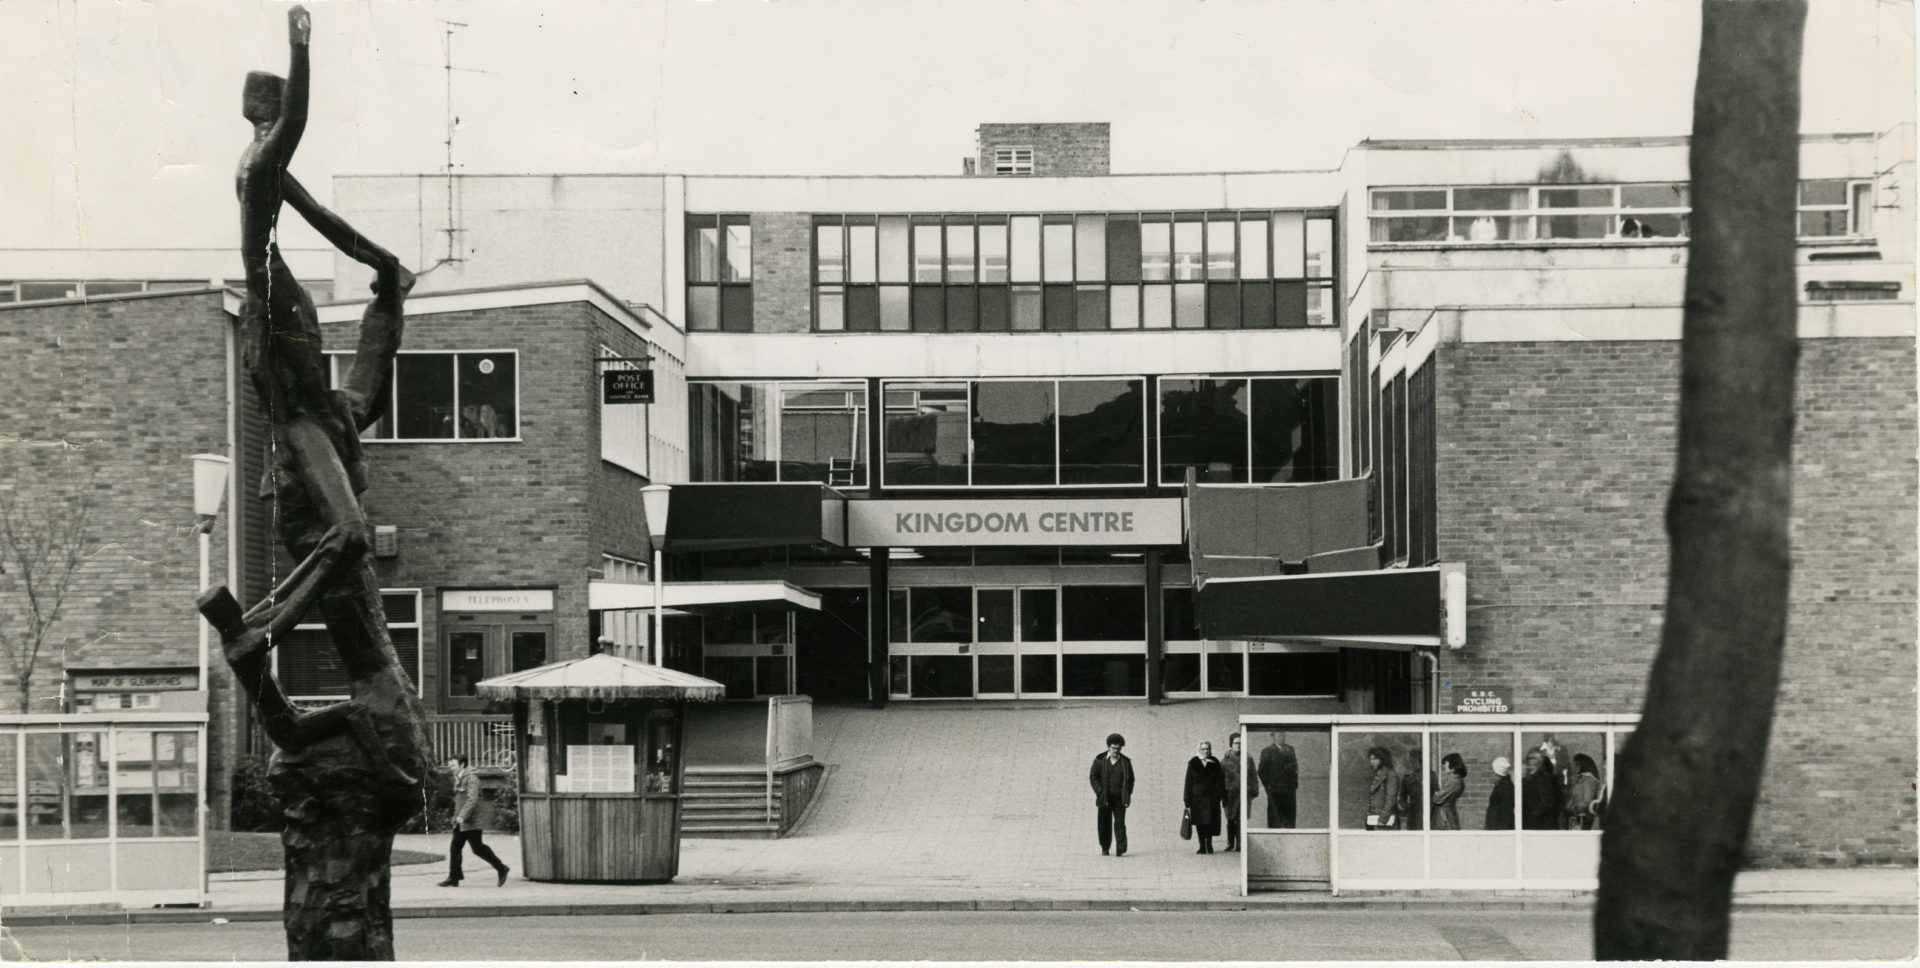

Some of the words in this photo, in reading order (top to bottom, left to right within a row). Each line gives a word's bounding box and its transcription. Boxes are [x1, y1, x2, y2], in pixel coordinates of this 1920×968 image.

[617, 374, 640, 382] POST
[612, 382, 645, 390] OFFICE
[896, 512, 1029, 533] KINGDOM
[1038, 512, 1133, 532] CENTRE
[467, 596, 529, 604] TELEPHONES
[91, 678, 110, 686] MAP
[114, 678, 124, 686] OF
[130, 677, 181, 686] GLENROTHES
[1463, 697, 1502, 705] CYCLING
